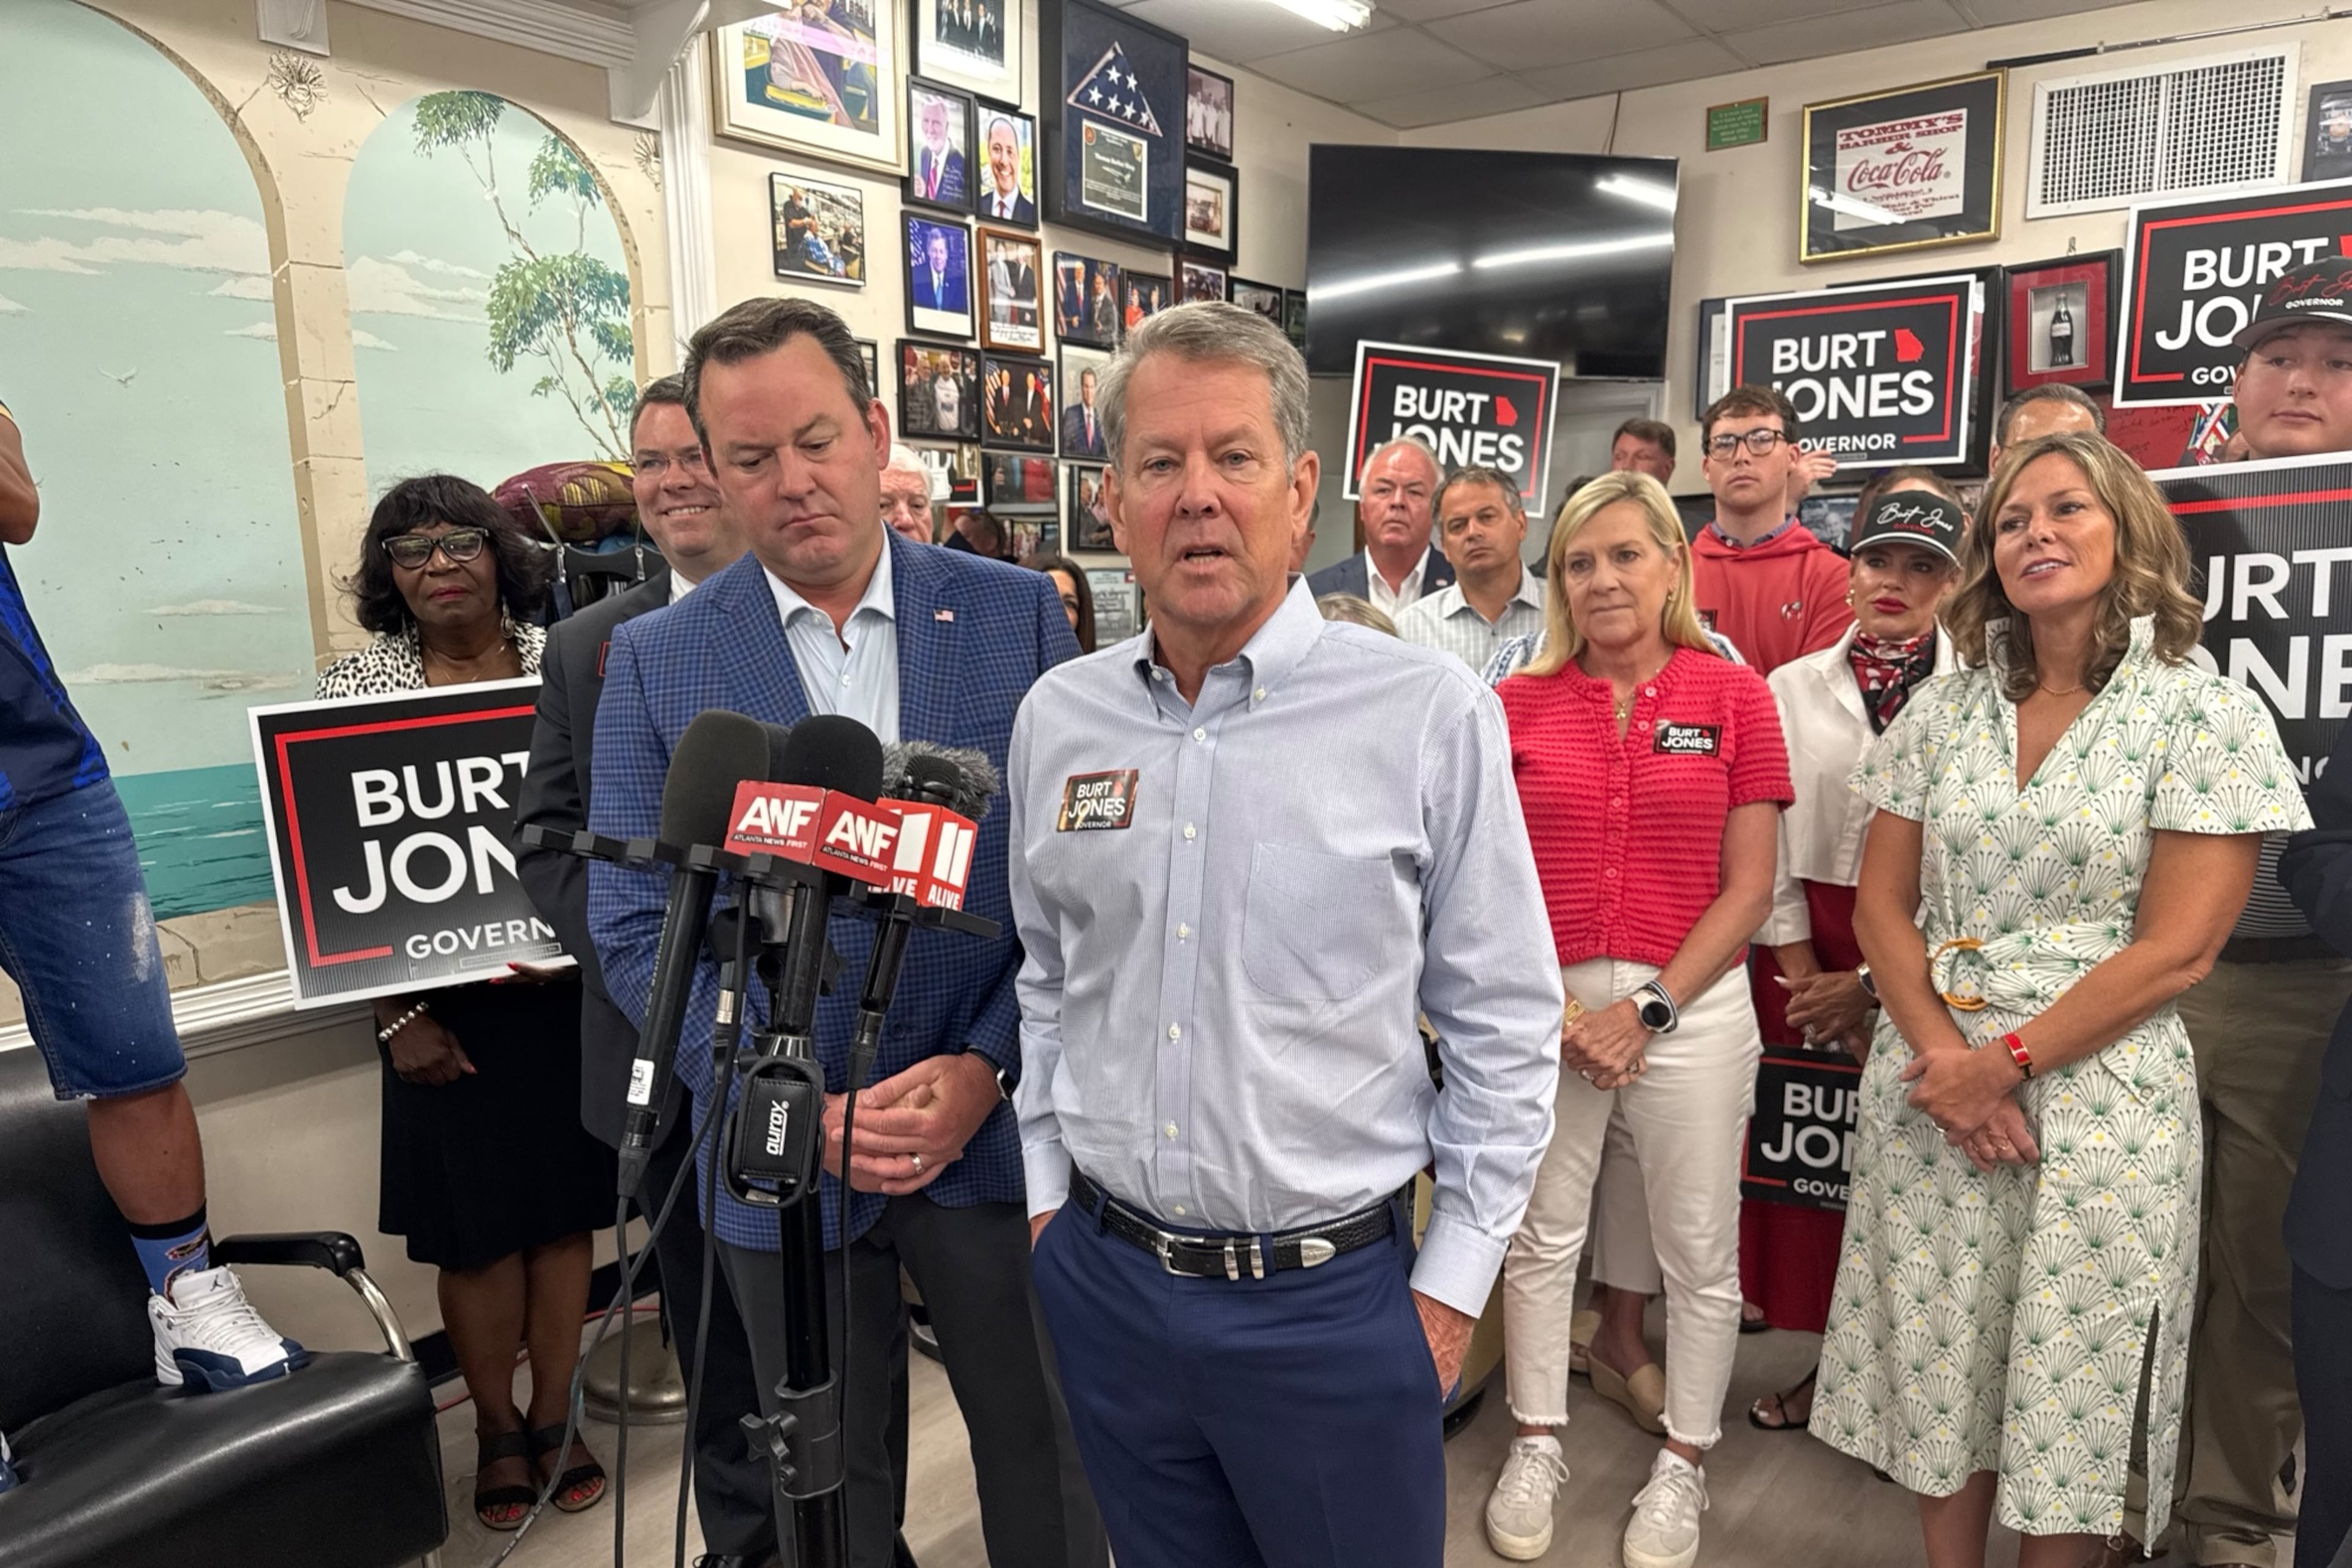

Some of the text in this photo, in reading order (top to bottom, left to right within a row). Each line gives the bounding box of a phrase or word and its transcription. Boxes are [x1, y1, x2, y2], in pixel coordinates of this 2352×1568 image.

[1839, 113, 1963, 141] TOMMY'S
[1839, 124, 1962, 150] BARBER SHOP
[1885, 142, 1913, 154] &
[1847, 148, 1947, 192] Coca-Cola
[2183, 236, 2329, 292] BURT
[2285, 298, 2344, 309] GOVERNOR
[2155, 294, 2263, 350] JO
[1773, 330, 1886, 374] BURT
[1393, 385, 1490, 424] BURT
[1772, 369, 1934, 423] ONES
[1877, 502, 1925, 525] Burt
[1662, 737, 1713, 749] JONES
[1668, 727, 1702, 737] BURT
[1077, 781, 1112, 799] BURT
[736, 796, 820, 837] ANF
[1069, 797, 1126, 818] JONES
[734, 834, 809, 849] ATLANTA NEWS FIRST
[826, 810, 899, 859] ANF
[822, 846, 888, 872] ATLANTA NEWS FIRST
[927, 884, 960, 911] ALIVE
[765, 1099, 789, 1156] auray
